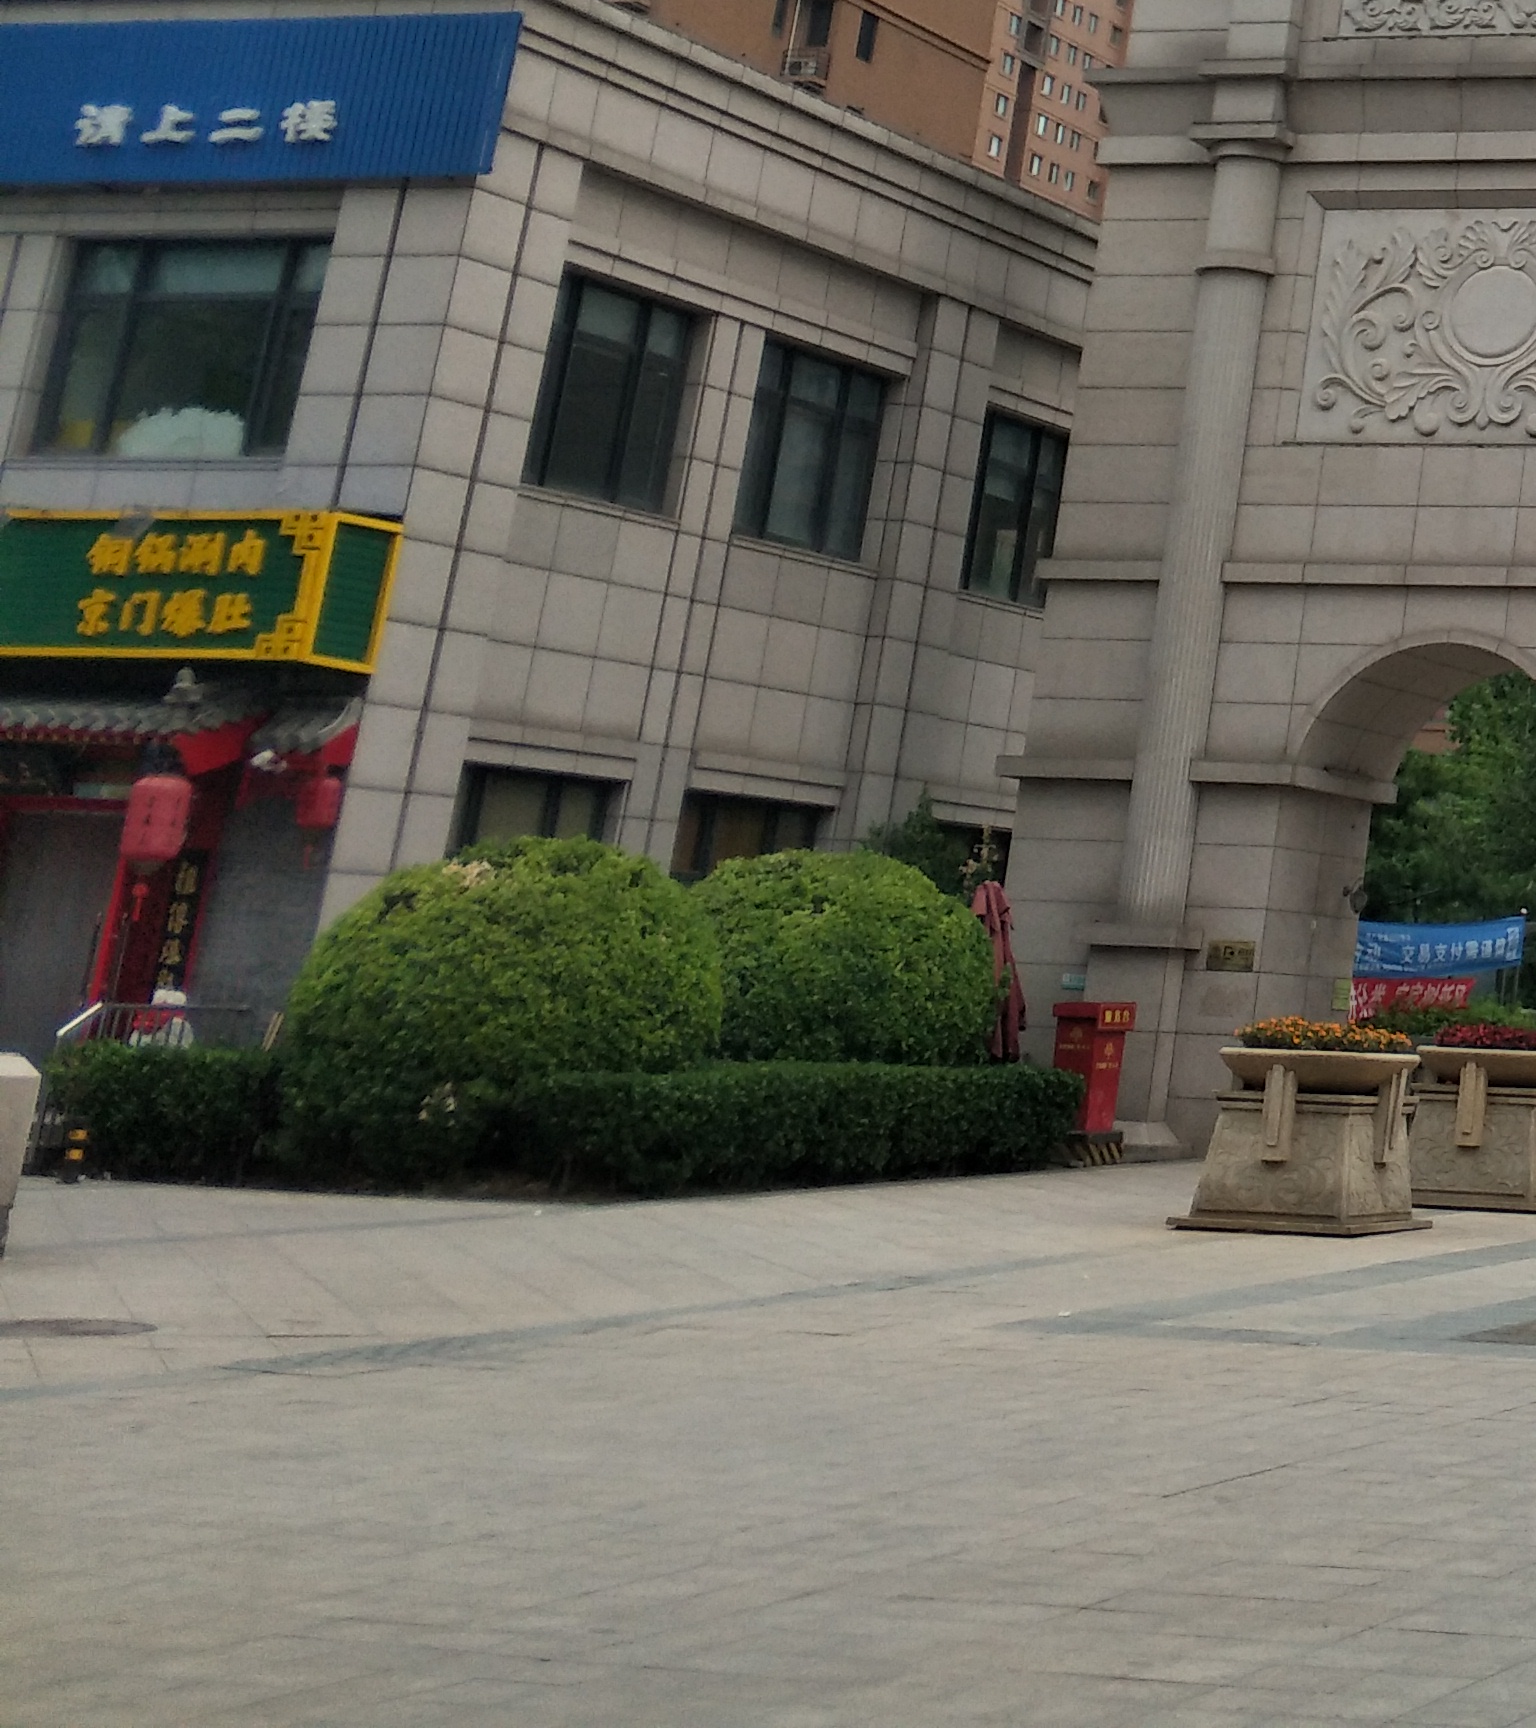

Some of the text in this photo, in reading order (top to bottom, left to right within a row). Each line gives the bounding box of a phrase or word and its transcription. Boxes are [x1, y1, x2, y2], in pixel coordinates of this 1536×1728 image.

[75, 100, 337, 146] 请上二楼
[86, 529, 266, 576] 铜锅涮肉
